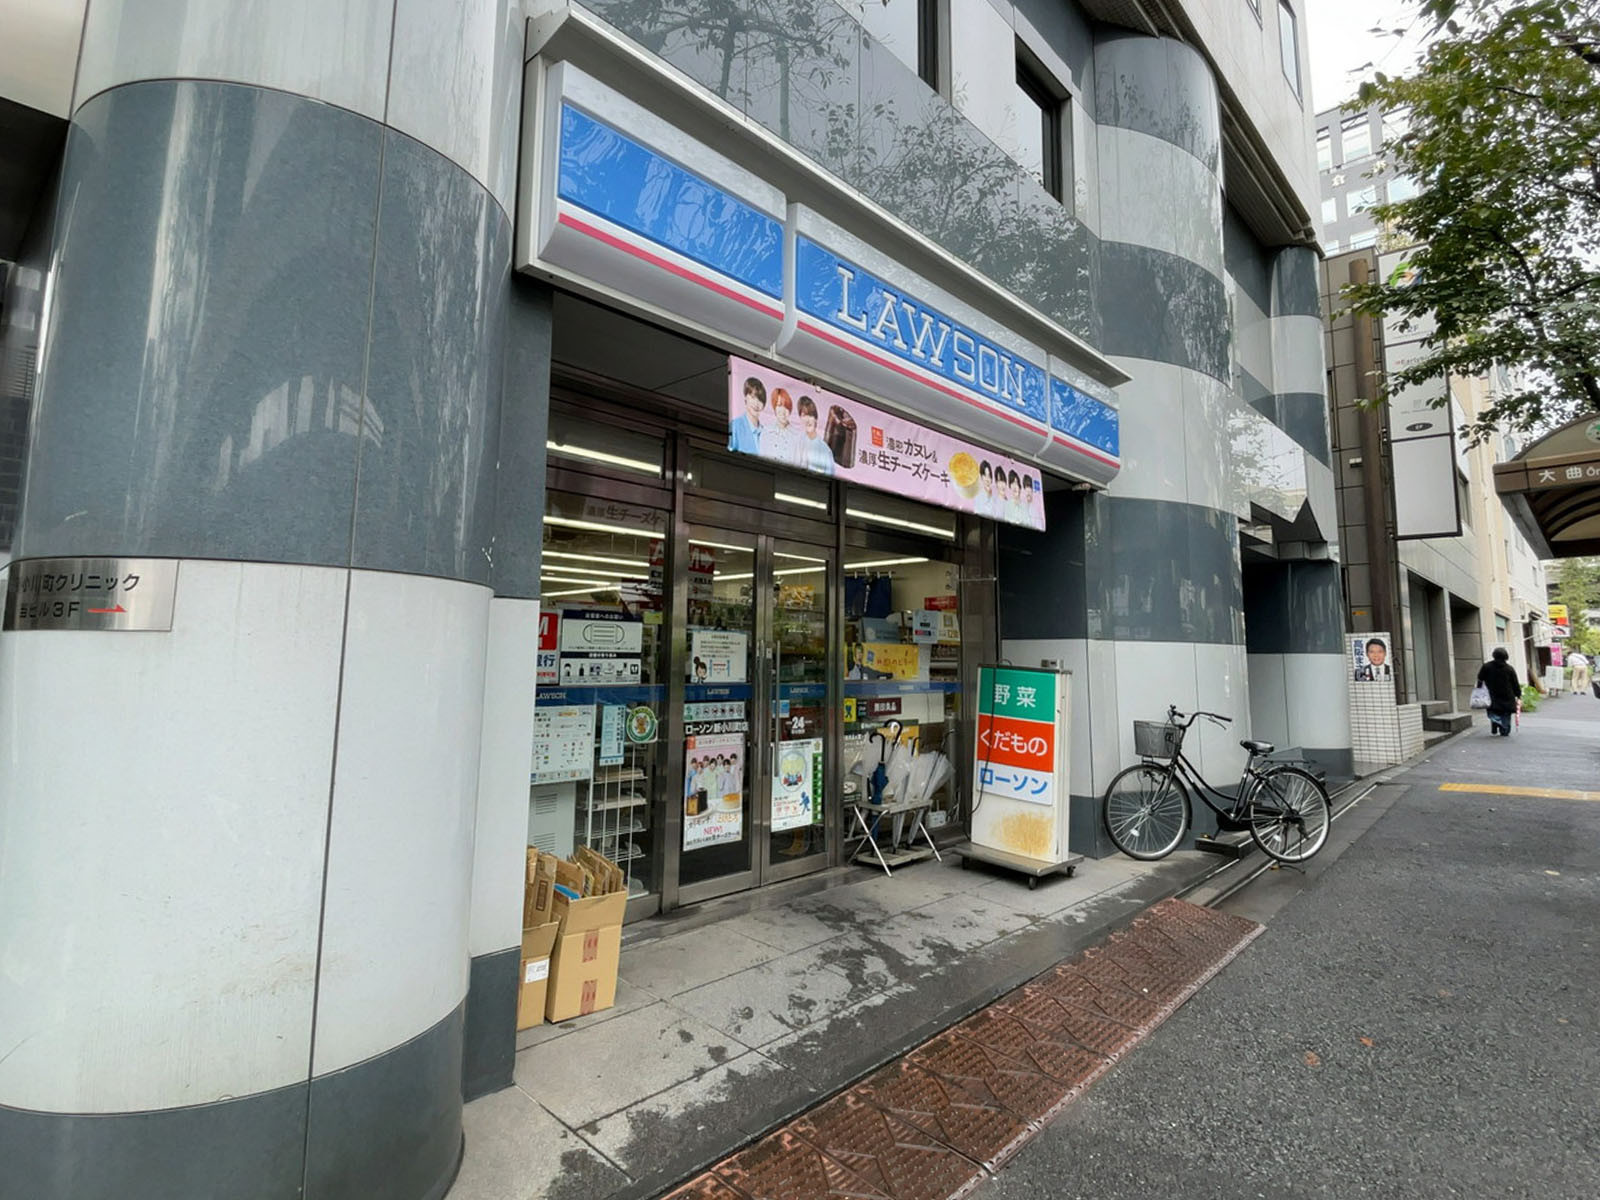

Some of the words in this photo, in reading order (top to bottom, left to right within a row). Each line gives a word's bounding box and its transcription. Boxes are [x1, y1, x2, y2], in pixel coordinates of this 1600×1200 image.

[837, 267, 1026, 406] LAWSON
[858, 449, 950, 488] 濃厚生チーズケーキ
[995, 684, 1036, 707] 野菜
[792, 716, 804, 729] 24
[980, 728, 1048, 757] くだもの
[979, 767, 1048, 795] ローソン
